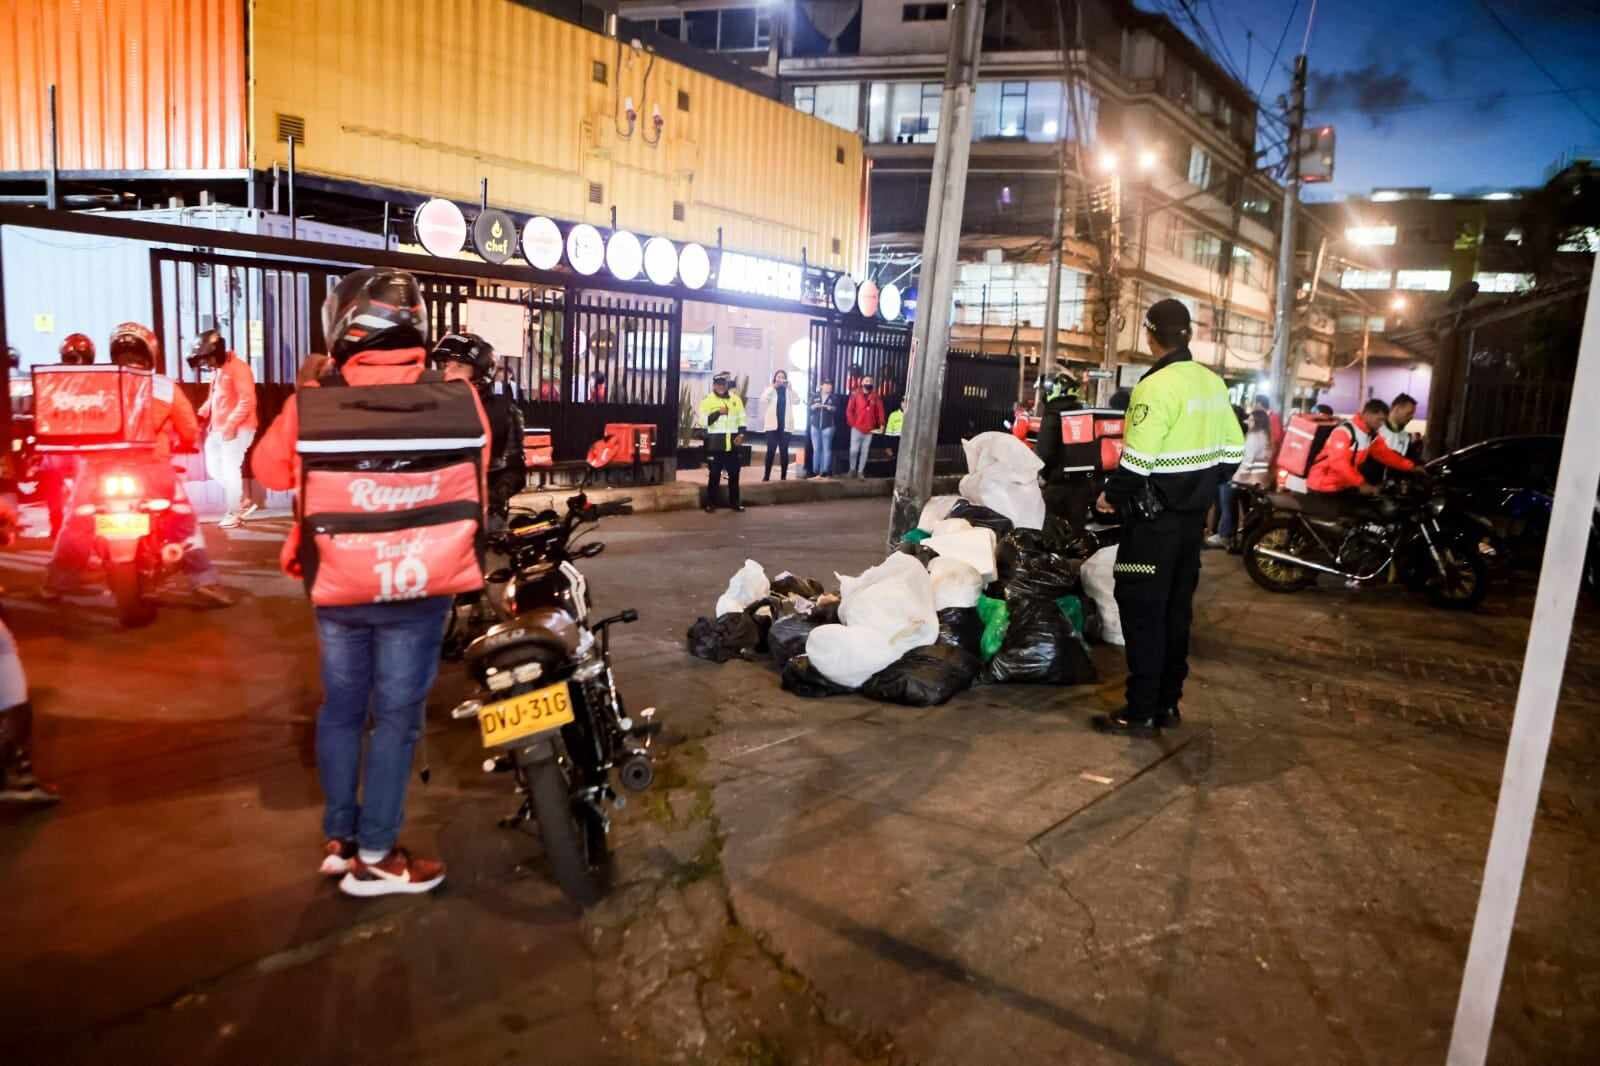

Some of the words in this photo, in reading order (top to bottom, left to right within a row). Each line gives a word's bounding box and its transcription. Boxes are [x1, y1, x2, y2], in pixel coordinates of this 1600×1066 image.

[485, 238, 508, 255] chef
[347, 474, 441, 511] Rappi
[373, 559, 428, 597] 10
